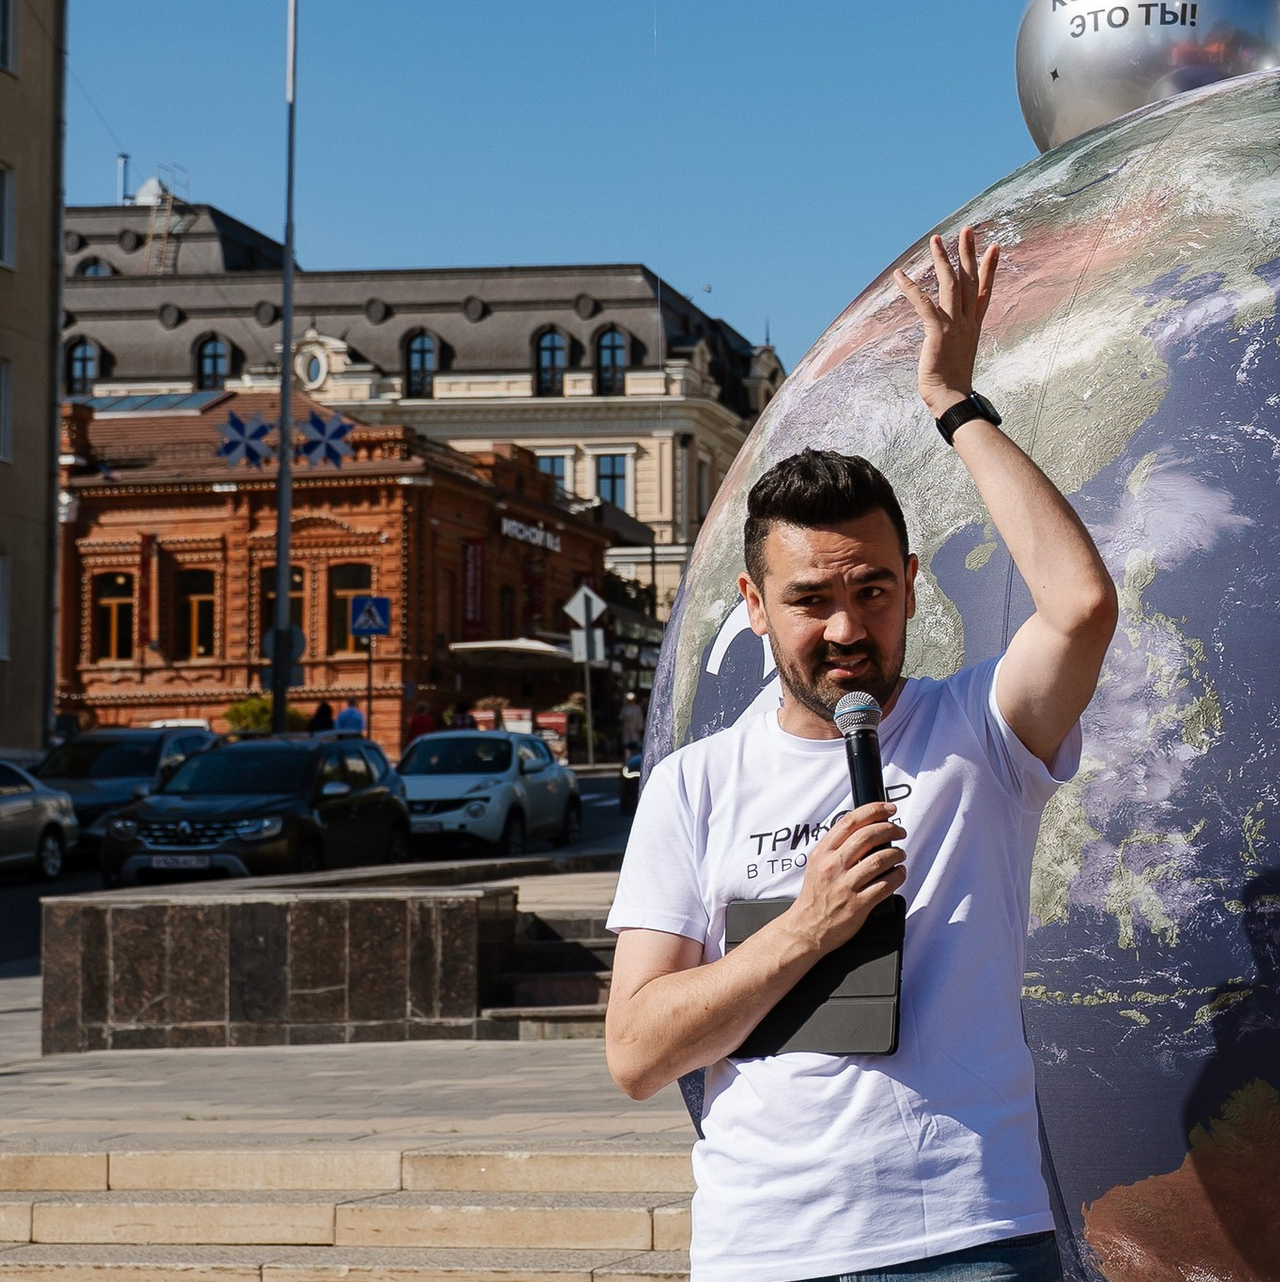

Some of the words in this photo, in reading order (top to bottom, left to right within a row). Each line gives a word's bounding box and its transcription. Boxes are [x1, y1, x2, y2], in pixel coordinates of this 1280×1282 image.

[1069, 6, 1130, 39] ЭТО
[1138, 3, 1198, 28] ТЫ!
[767, 853, 808, 875] ТВО
